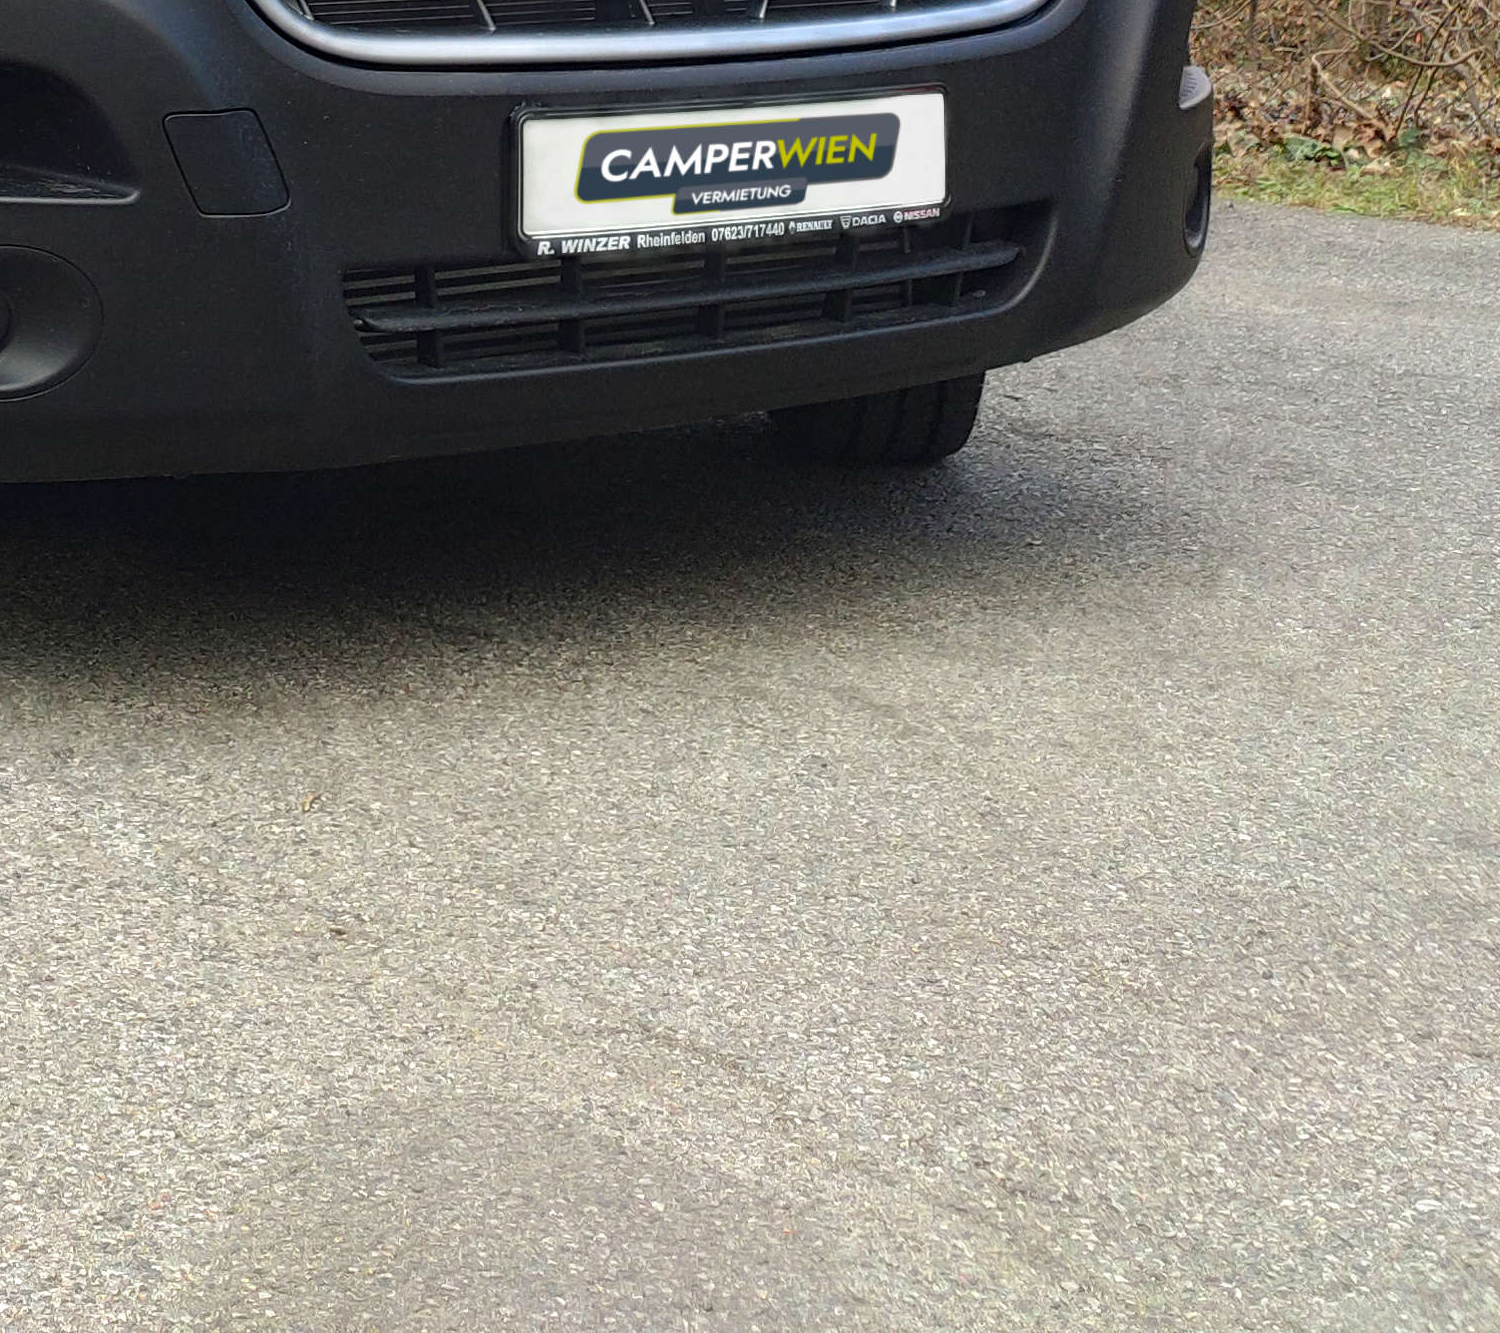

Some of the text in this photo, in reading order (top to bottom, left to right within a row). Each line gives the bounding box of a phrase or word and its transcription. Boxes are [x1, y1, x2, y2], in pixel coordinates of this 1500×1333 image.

[600, 132, 878, 182] CAMPERWIEN
[691, 184, 792, 205] VERMIETUNG
[537, 207, 941, 255] R. WINZER Rheinfelden 07623/717440 RENAULT DACIA NISSAN
